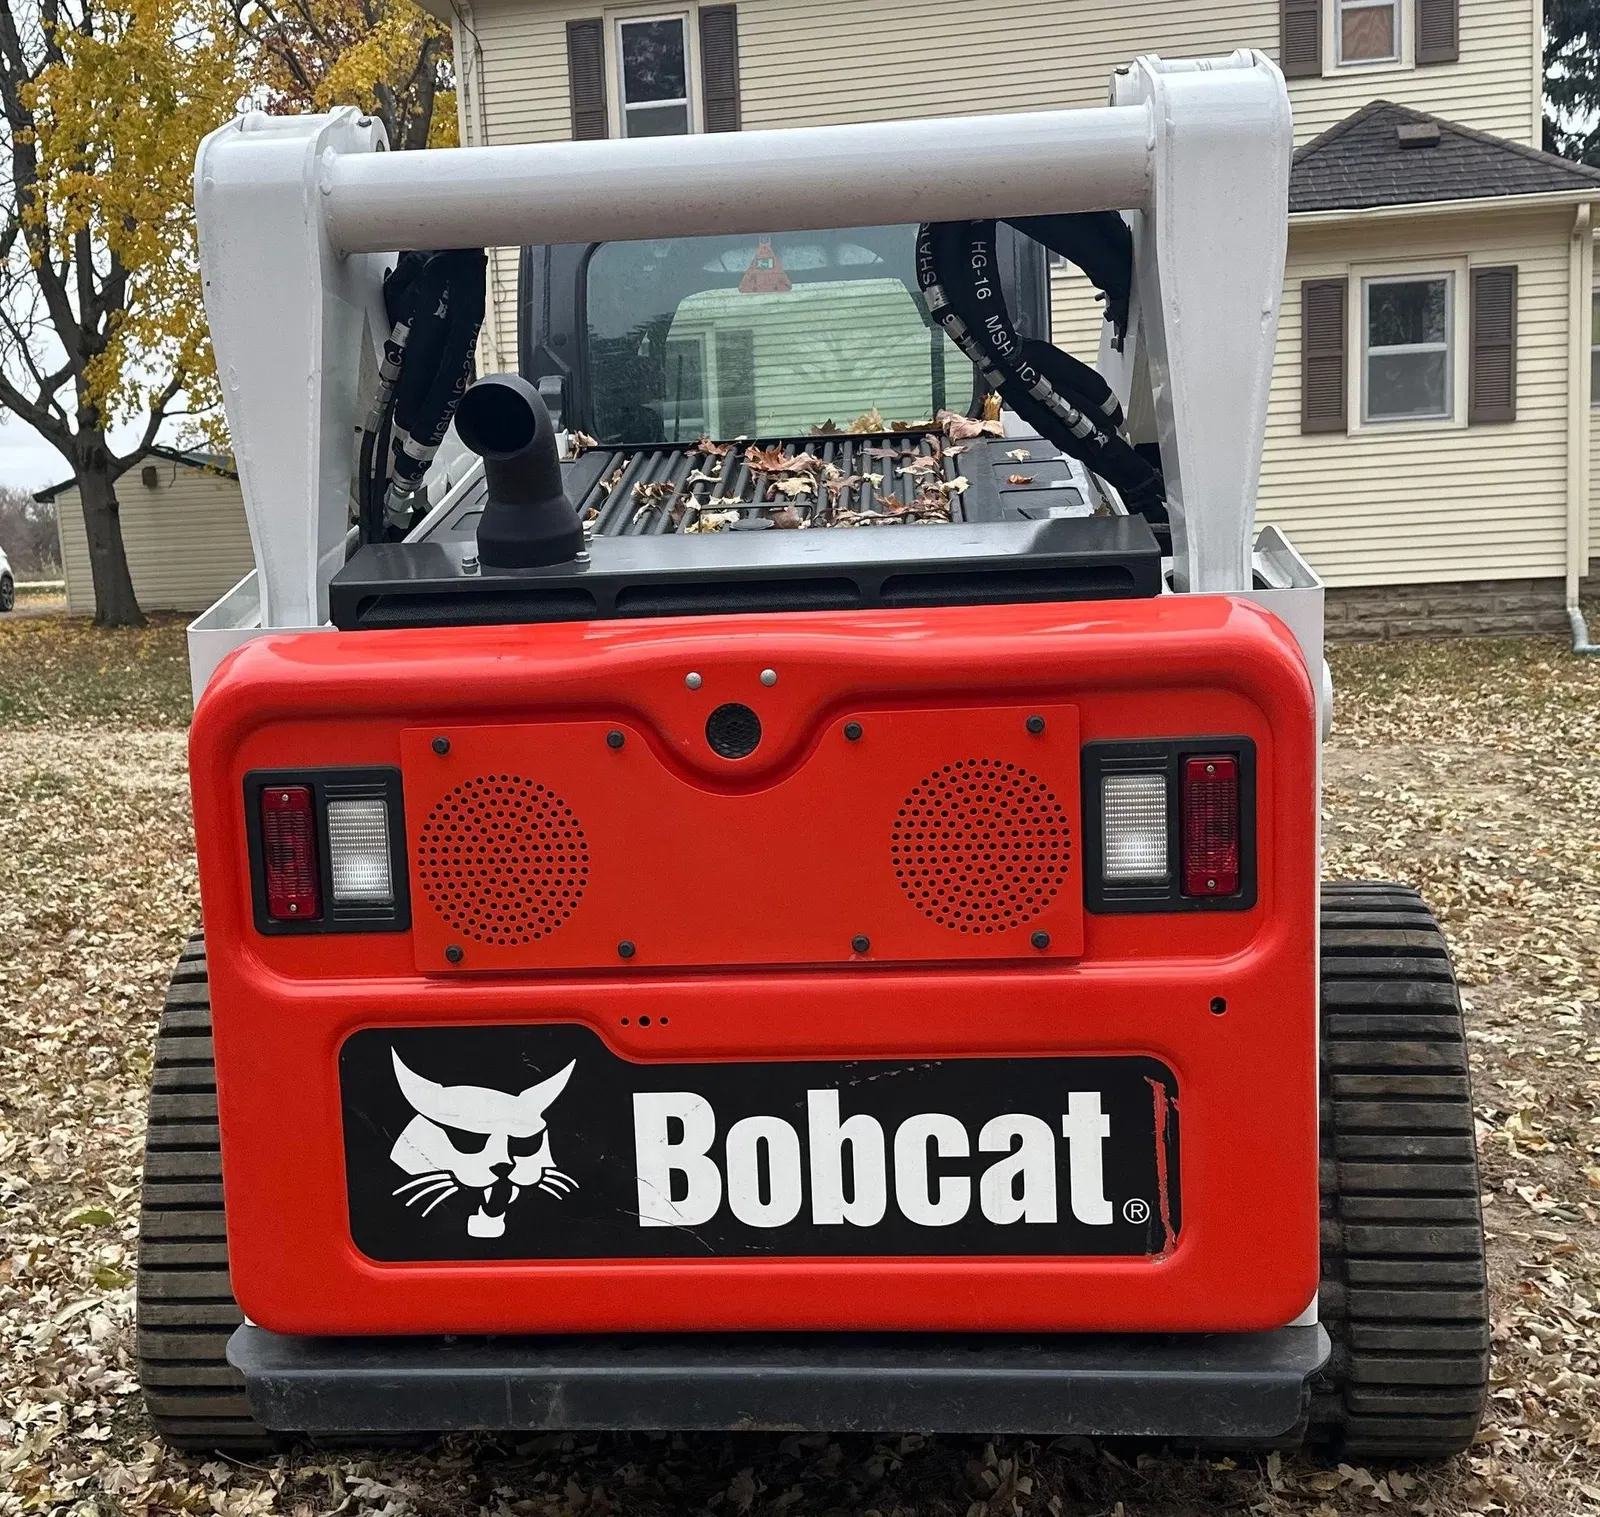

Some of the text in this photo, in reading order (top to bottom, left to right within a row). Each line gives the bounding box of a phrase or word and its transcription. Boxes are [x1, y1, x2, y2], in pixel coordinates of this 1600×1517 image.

[971, 241, 992, 300] HG-16
[984, 314, 1014, 357] MSH
[430, 399, 460, 443] MSHA
[632, 1089, 1114, 1228] Bobcat
